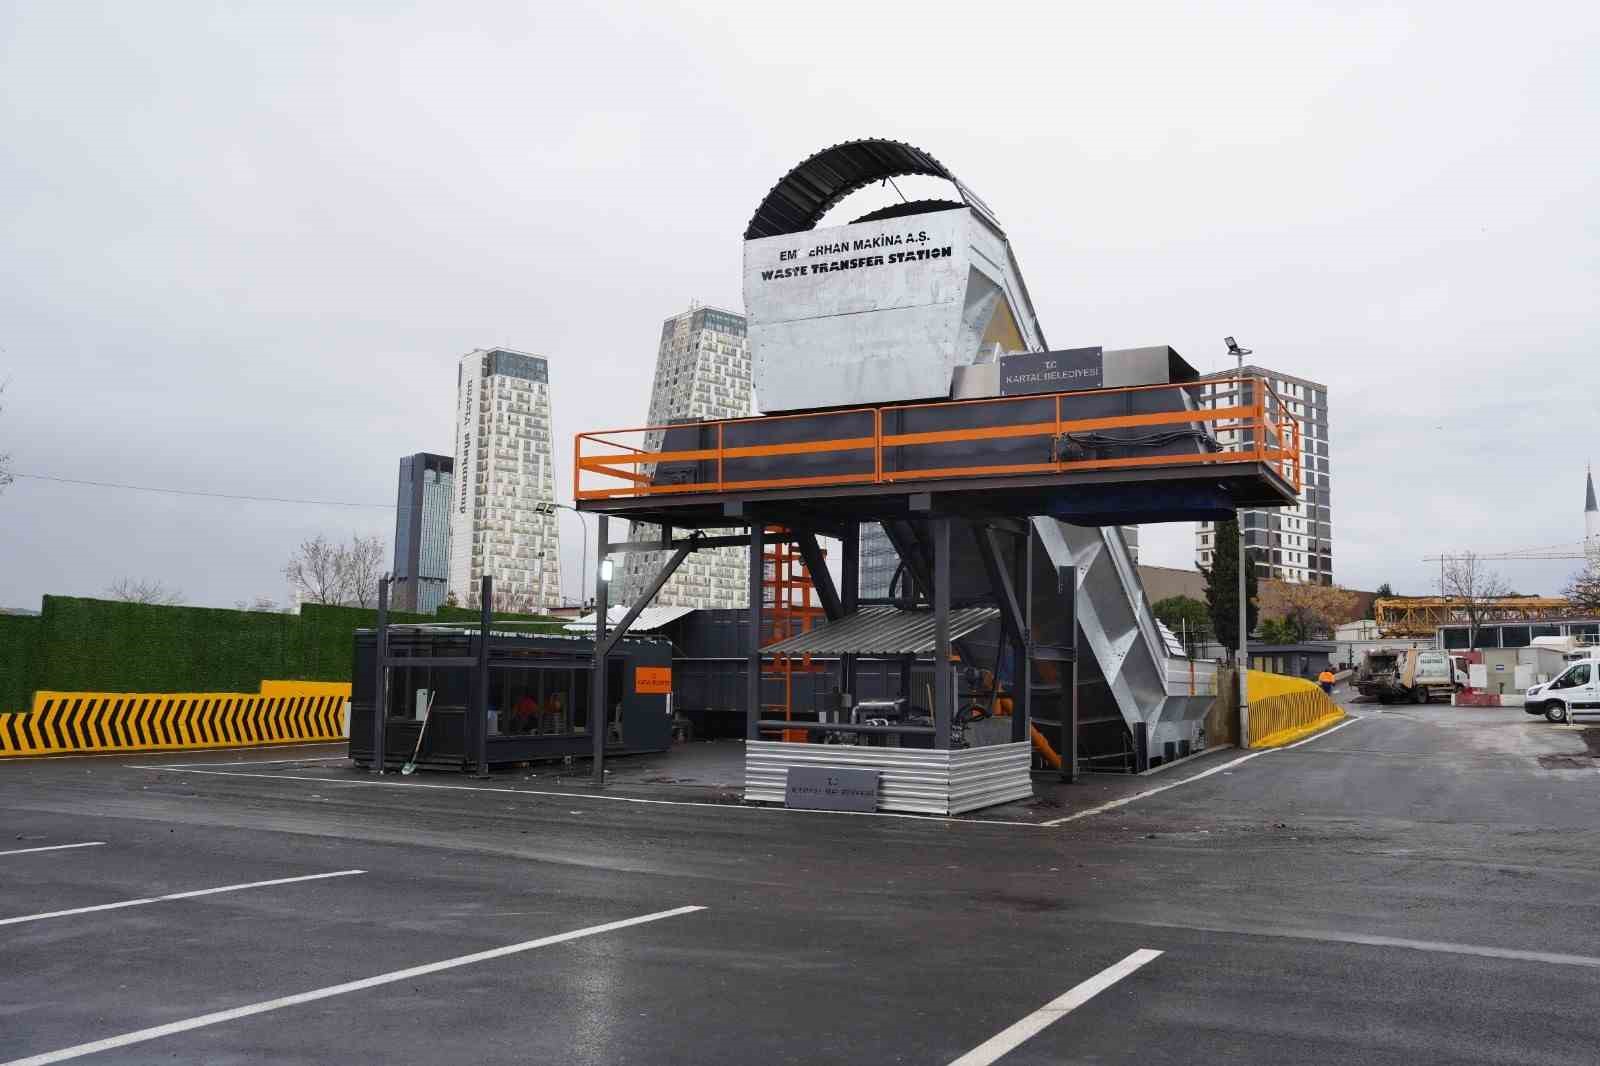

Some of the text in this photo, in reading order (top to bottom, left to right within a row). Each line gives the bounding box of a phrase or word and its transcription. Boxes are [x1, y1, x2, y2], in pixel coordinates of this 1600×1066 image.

[853, 233, 903, 251] MAKİNA
[762, 246, 952, 281] WASTE TRANSFER STATION
[1006, 373, 1041, 384] KARTAL
